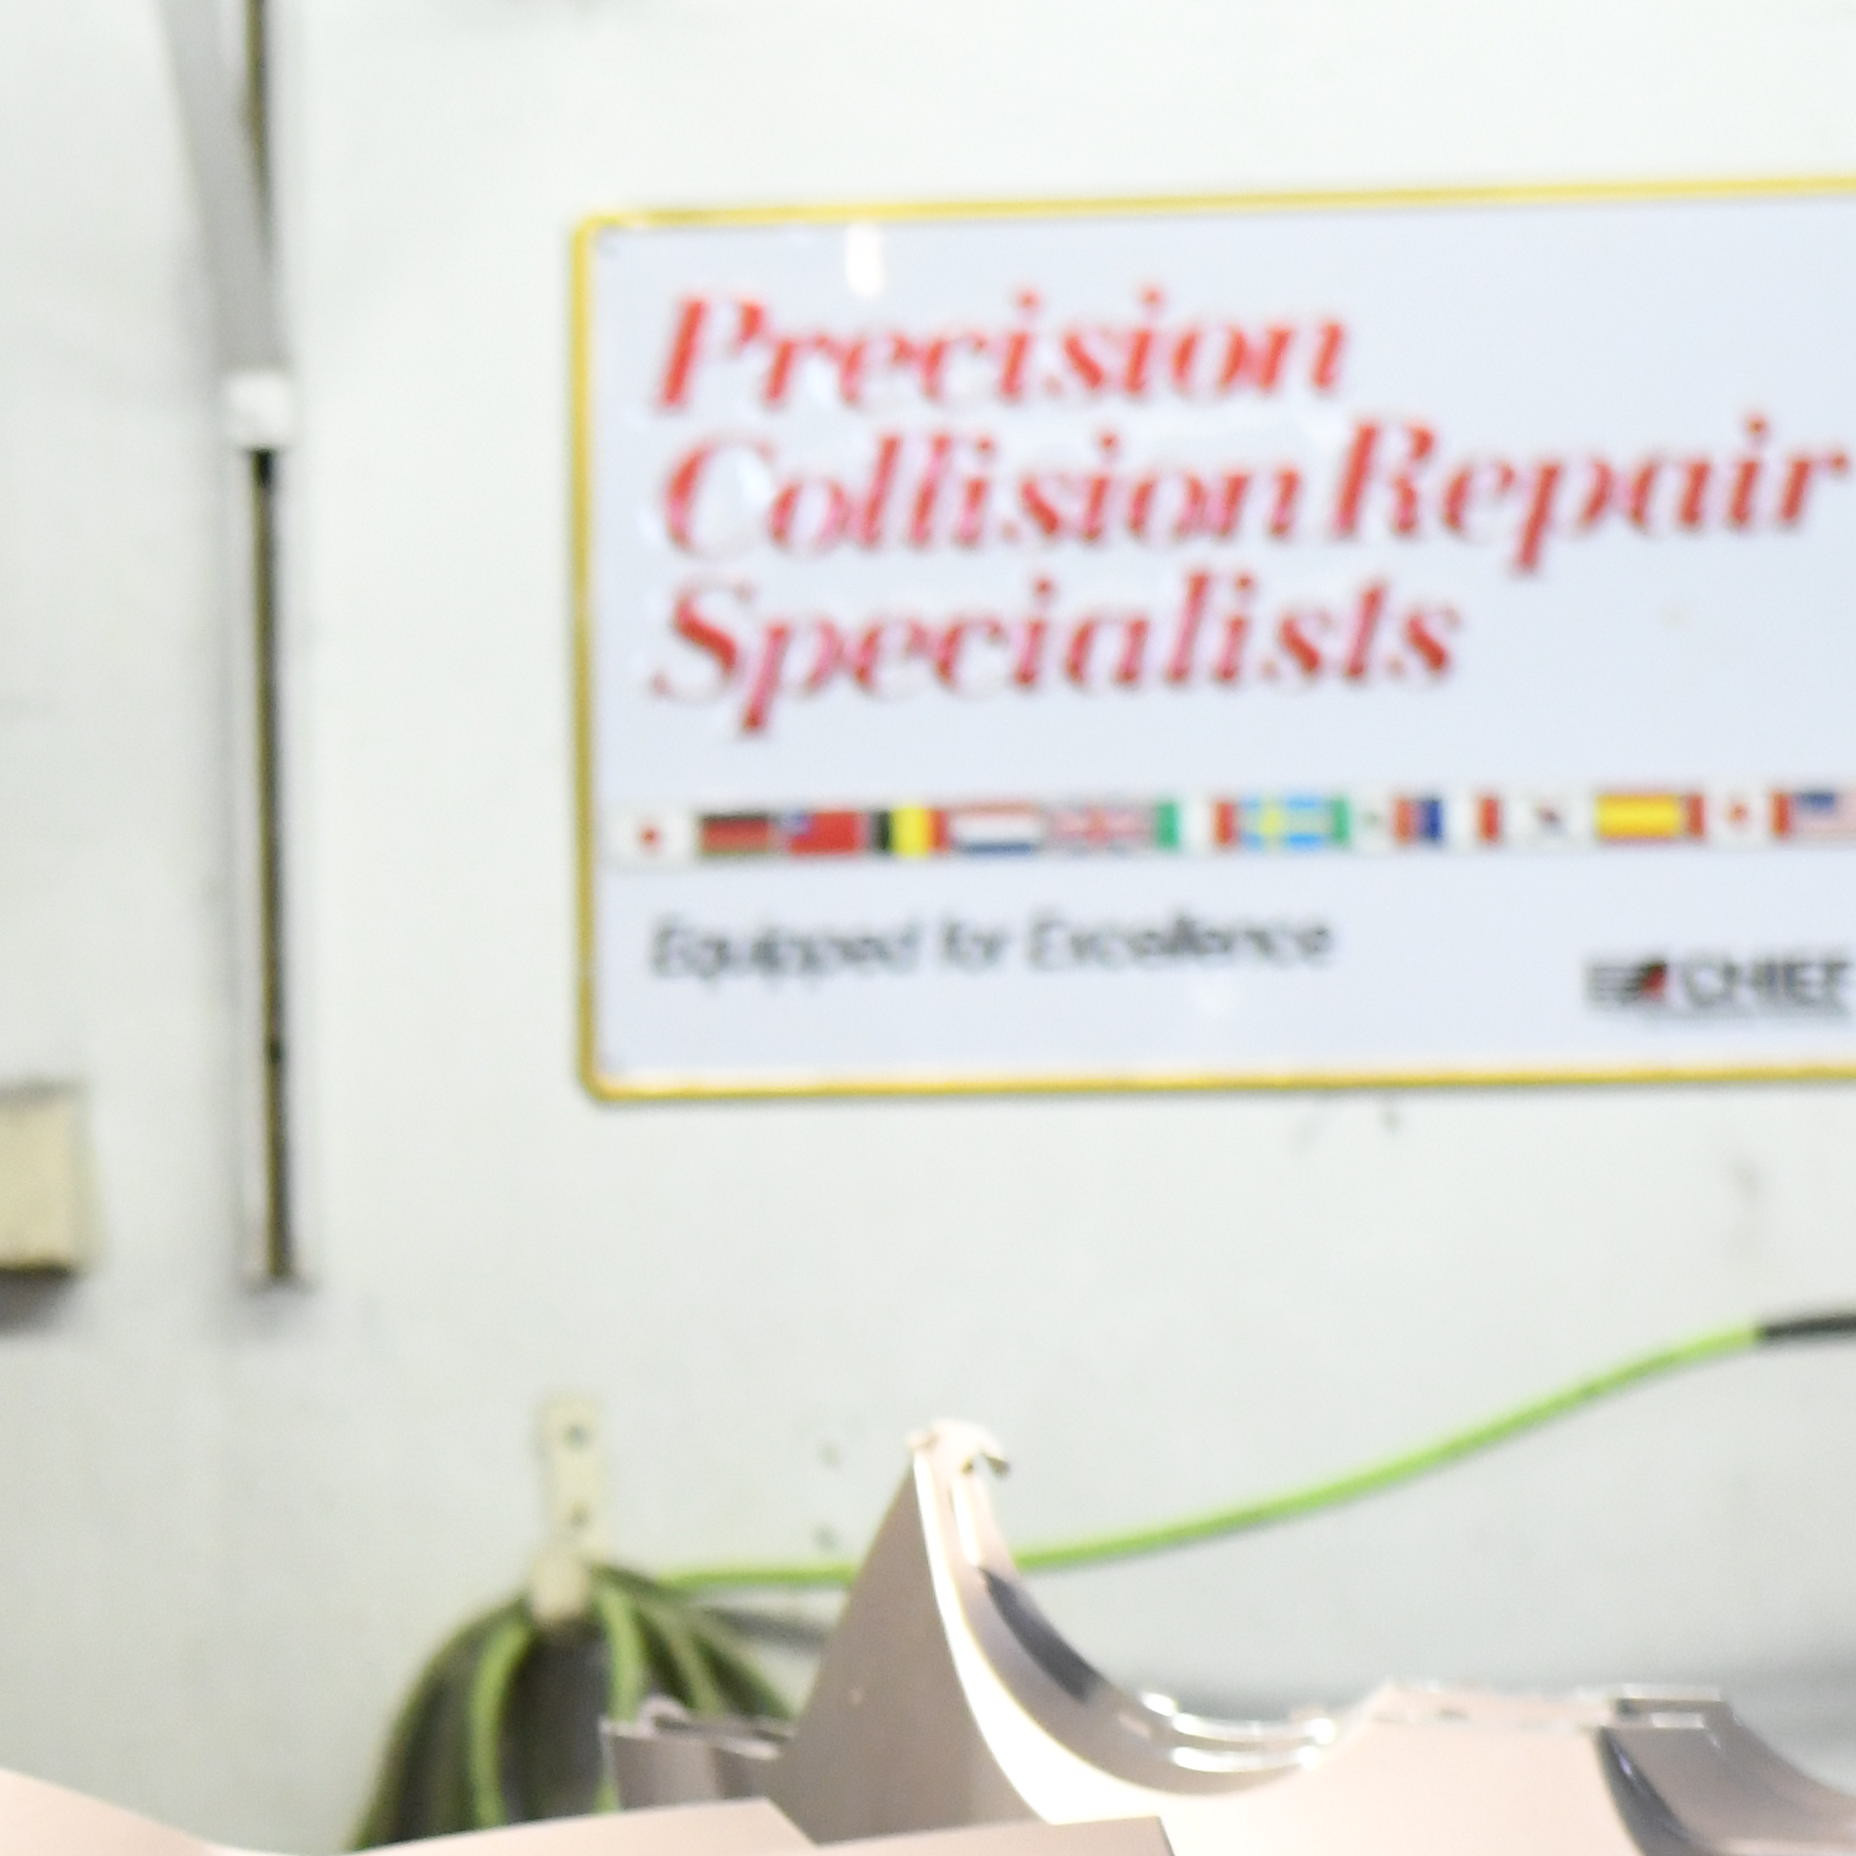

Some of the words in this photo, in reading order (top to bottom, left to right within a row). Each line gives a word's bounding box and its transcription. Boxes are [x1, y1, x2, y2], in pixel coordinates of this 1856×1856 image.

[657, 285, 1345, 411] Precision
[660, 425, 1303, 557] Collision
[1325, 412, 1851, 576] Repair
[648, 568, 1463, 737] Specialists
[650, 910, 924, 990] Equipped
[940, 908, 1010, 972] for
[1024, 904, 1336, 974] Excellence
